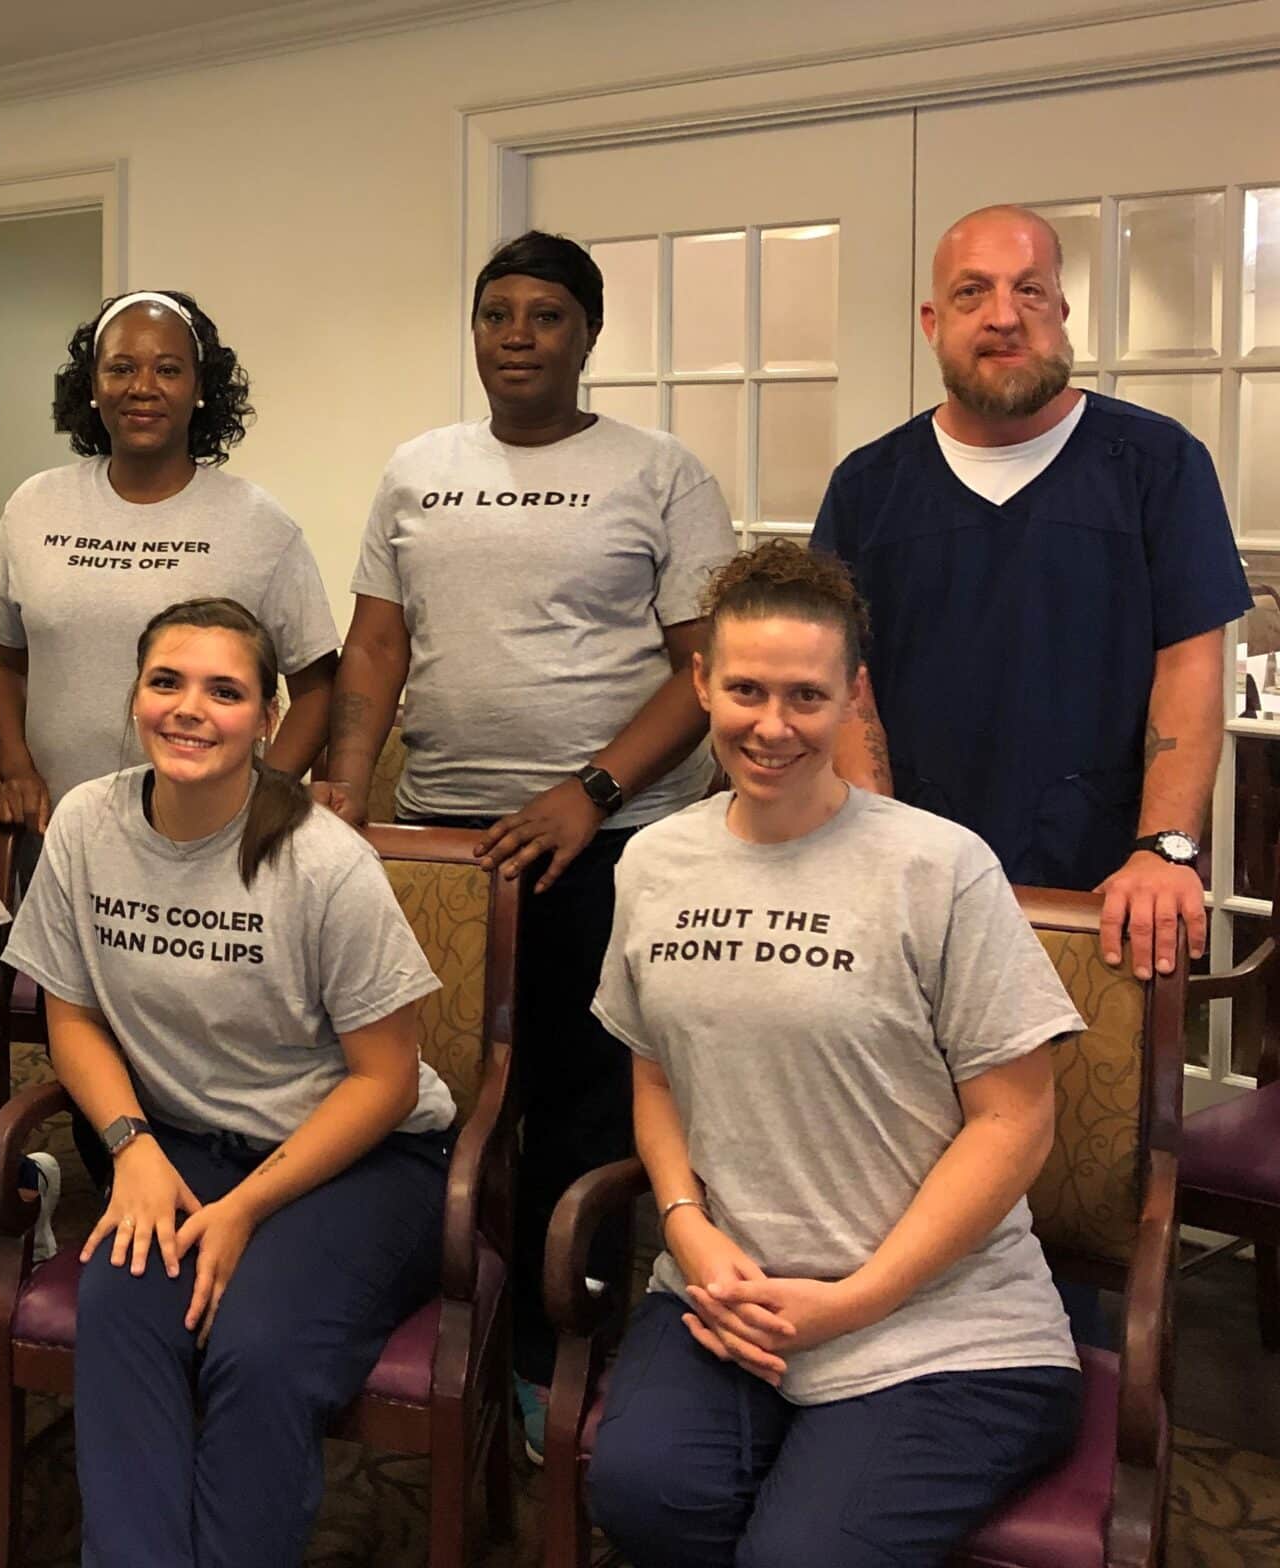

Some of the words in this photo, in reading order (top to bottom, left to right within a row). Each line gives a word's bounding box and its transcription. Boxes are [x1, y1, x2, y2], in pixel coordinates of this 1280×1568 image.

[422, 491, 464, 509] OH
[476, 491, 590, 507] LORD!!
[44, 534, 71, 546] MY
[75, 537, 136, 552] BRAIN
[142, 541, 210, 553] NEVER
[67, 555, 132, 569] SHUTS
[139, 558, 179, 569] OFF
[166, 907, 264, 933] COOLER
[675, 908, 753, 929] SHUT
[766, 909, 831, 934] THE
[152, 935, 205, 960] DOG
[211, 941, 264, 964] LIPS
[650, 940, 743, 963] FRONT
[755, 941, 855, 972] DOOR
